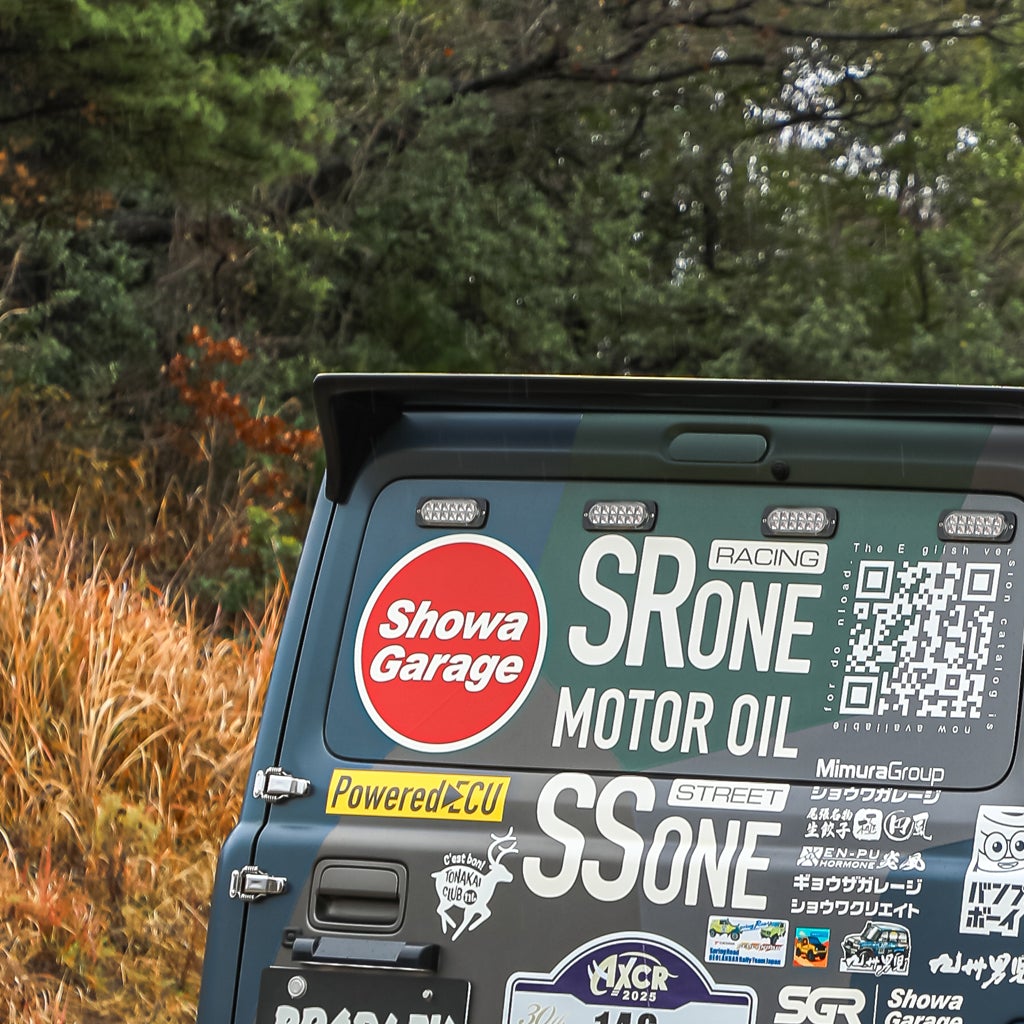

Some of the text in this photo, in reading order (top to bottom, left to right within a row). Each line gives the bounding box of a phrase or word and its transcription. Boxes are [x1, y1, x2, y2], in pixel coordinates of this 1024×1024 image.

[716, 547, 820, 567] RACING
[853, 542, 883, 553] The
[898, 543, 969, 556] Eglish
[378, 599, 529, 641] Showa
[989, 618, 1008, 698] catalog
[369, 645, 524, 693] Garage
[823, 683, 836, 712] for
[552, 686, 799, 759] MOTOR OIL
[815, 758, 945, 786] MimuraGroup
[676, 784, 784, 806] STREET
[810, 786, 942, 805] ショウワガレージ
[819, 861, 877, 870] HORMONE
[445, 869, 482, 888] TONAKAI
[793, 874, 923, 895] ギョウザガレージ
[442, 886, 462, 902] CLUB
[791, 899, 920, 919] ショウワクリエイト
[966, 906, 1019, 931] ボーイ
[588, 952, 673, 996] AXCR
[622, 990, 657, 1002] 2025
[887, 988, 964, 1011] Showa
